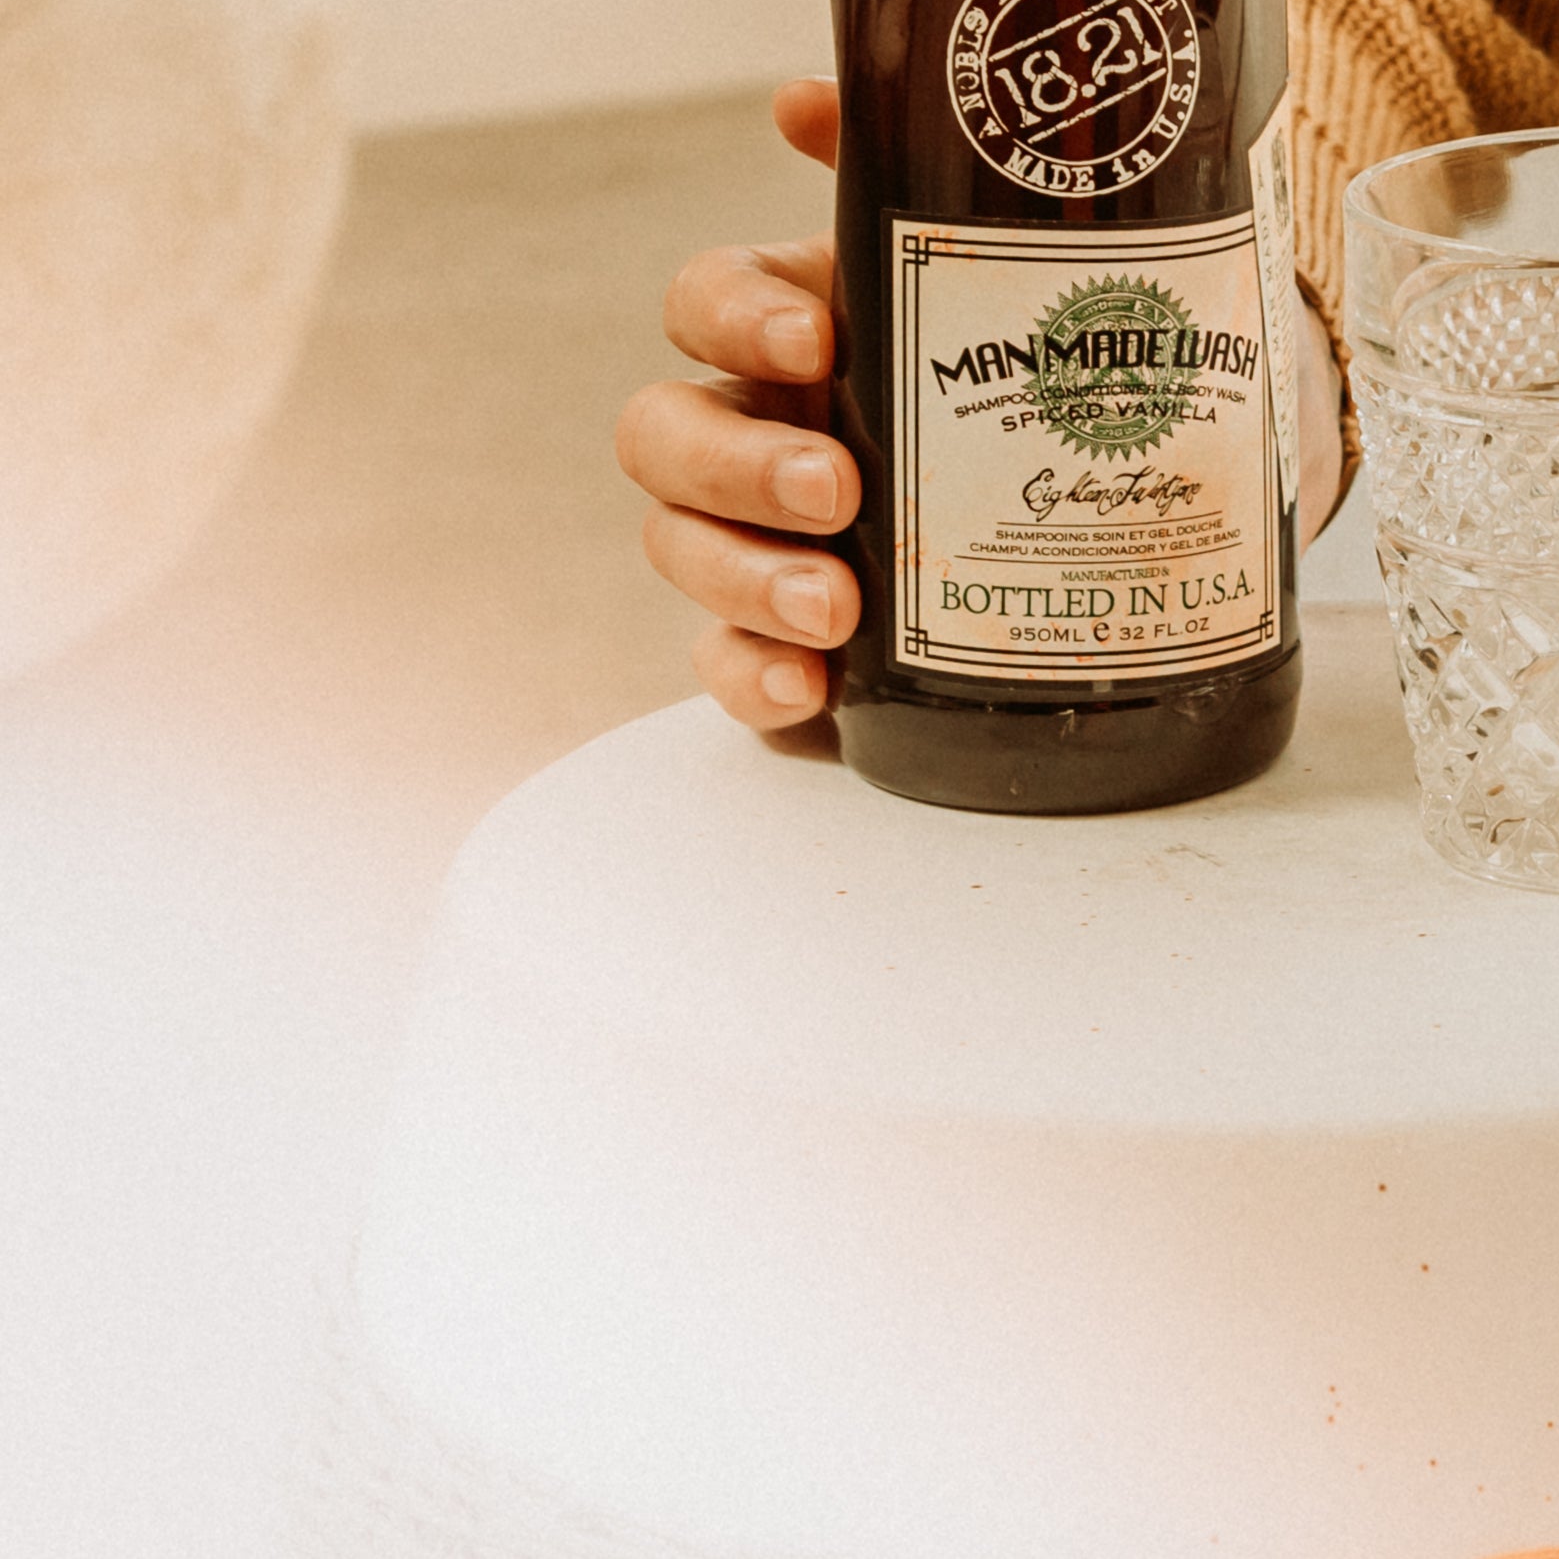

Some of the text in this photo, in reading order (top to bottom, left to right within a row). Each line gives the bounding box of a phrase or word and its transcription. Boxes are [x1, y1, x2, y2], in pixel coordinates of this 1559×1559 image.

[955, 6, 989, 112] NOBLE
[995, 7, 1162, 128] 18.21
[1003, 29, 1196, 191] MADE in U.S.A.
[978, 117, 1002, 139] A
[1174, 330, 1258, 381] WASH
[954, 391, 1036, 418] SHAMPOO
[1040, 383, 1156, 401] CONDITIONER
[1174, 384, 1214, 398] BODY
[1215, 387, 1246, 405] WASH
[1001, 402, 1103, 432] SPICED
[1115, 401, 1216, 424] VANILLA
[969, 542, 1028, 555] CHAMPU
[1031, 544, 1156, 557] ACONDICIONADOR
[1159, 543, 1167, 552] Y
[1169, 540, 1194, 551] GEL
[1196, 536, 1211, 548] DE
[995, 518, 1223, 542] SHAMPOOING SOIN ET GEL DOUCHE
[1060, 565, 1170, 582] MANUFACTURED &
[939, 568, 1255, 618] BOTTLED IN U.S.A.
[1009, 626, 1086, 643] 950ML
[1119, 626, 1145, 641] 32
